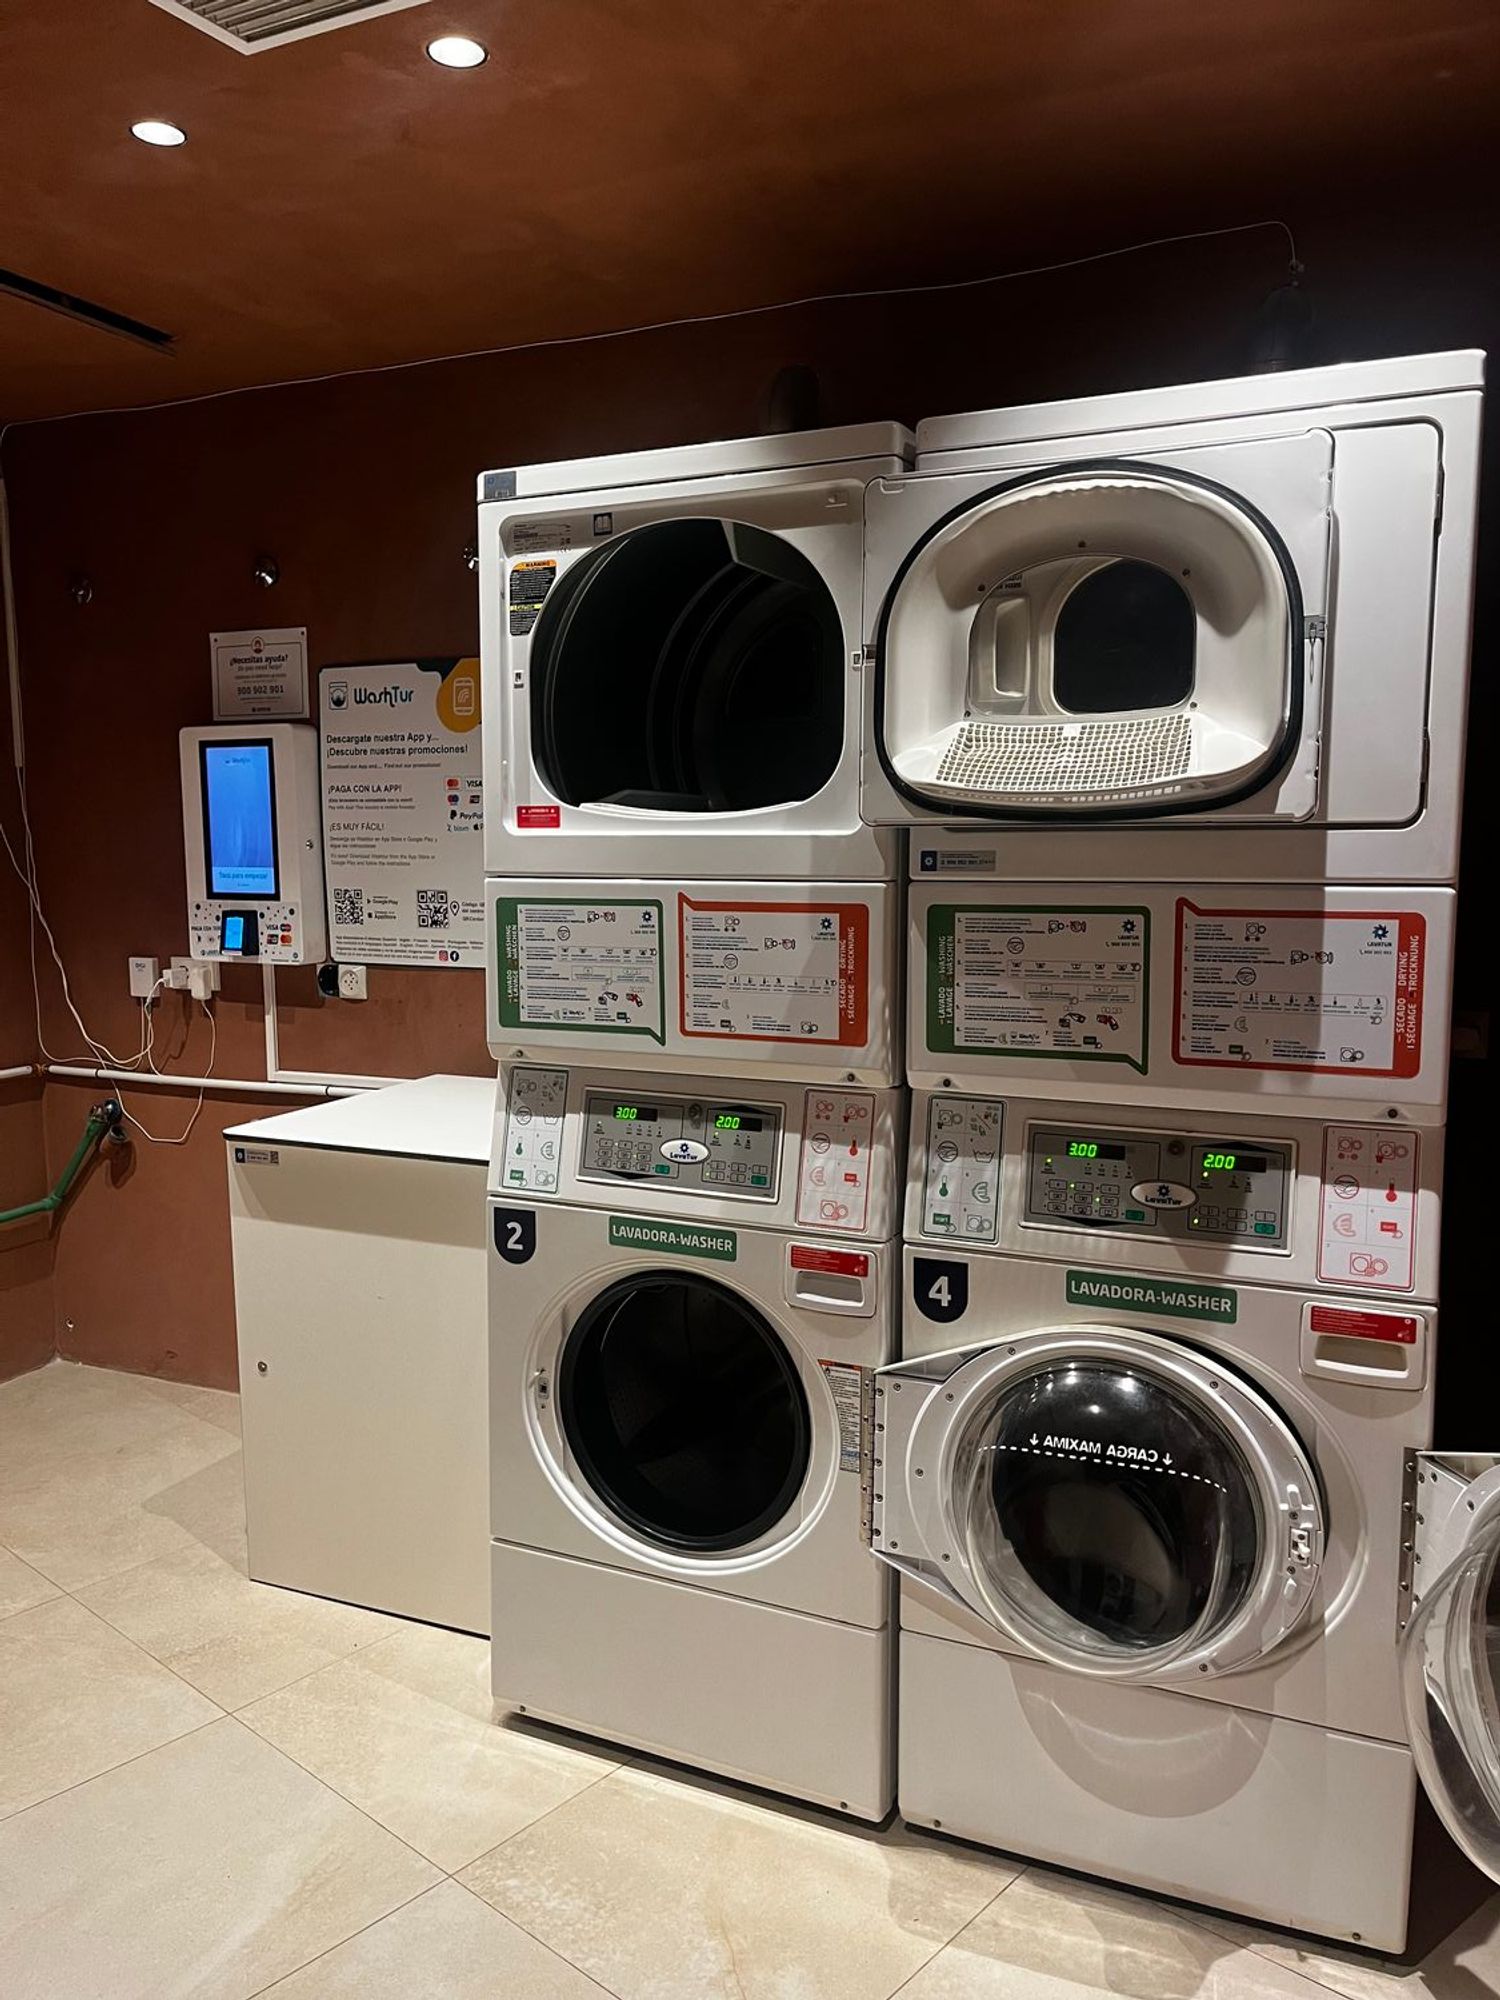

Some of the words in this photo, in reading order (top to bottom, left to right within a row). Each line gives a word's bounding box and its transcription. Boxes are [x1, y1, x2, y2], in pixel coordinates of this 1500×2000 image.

[354, 686, 414, 708] WashTur
[374, 734, 405, 743] nuestra
[407, 733, 424, 742] App
[370, 747, 406, 756] nuestras
[408, 744, 468, 756] promociones!
[353, 785, 370, 794] CON
[372, 784, 383, 793] LA
[1398, 951, 1408, 987] DRYING
[1408, 935, 1419, 991] TROCKNUNG
[1396, 997, 1406, 1033] SECADO
[615, 1107, 638, 1119] 3.00
[716, 1115, 740, 1129] 2.00
[1069, 1143, 1097, 1158] 3.00
[1204, 1154, 1235, 1169] 2.00
[506, 1221, 523, 1250] 2
[613, 1225, 733, 1252] LAVADORA-WASHER
[928, 1275, 951, 1307] 4
[1071, 1280, 1232, 1312] LAVADORA-WASHER
